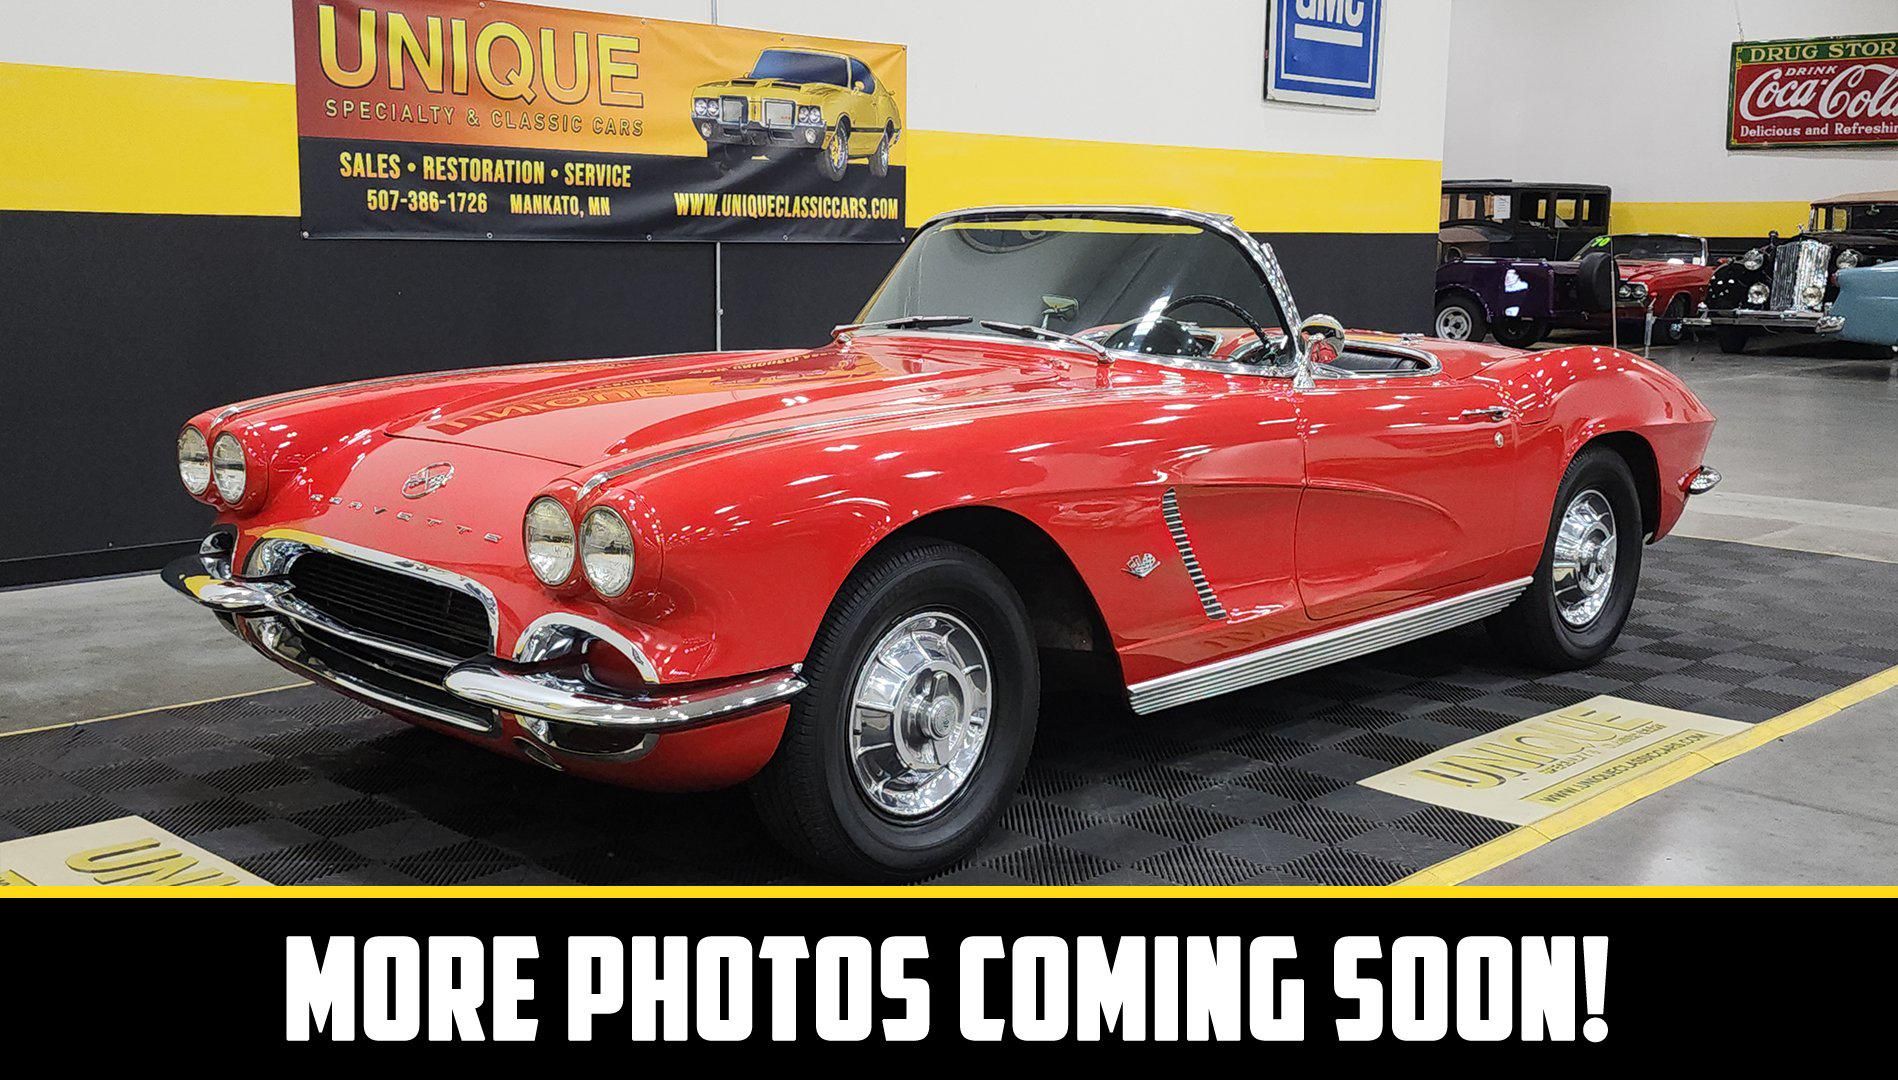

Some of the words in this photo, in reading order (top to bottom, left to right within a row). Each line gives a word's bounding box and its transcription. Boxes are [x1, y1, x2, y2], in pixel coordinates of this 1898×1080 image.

[317, 4, 644, 109] UNIQUE
[1750, 45, 1818, 62] DRUG
[1828, 41, 1898, 59] STOR
[1785, 65, 1838, 76] DRINK
[1739, 63, 1898, 121] Coca-Cola
[325, 98, 455, 125] SPECIALTY
[466, 108, 480, 127] &
[491, 109, 582, 133] CLASSIC
[592, 116, 643, 136] CARS
[1740, 125, 1801, 137] Delicious
[1805, 123, 1828, 135] and
[1834, 121, 1898, 134] Refreshi
[339, 151, 401, 179] SALES
[423, 155, 545, 185] RESTORATION
[564, 162, 632, 188] SERVICE
[366, 189, 488, 214] 507-386-1726
[510, 193, 585, 218] MANKATO,
[588, 196, 611, 216] MN
[673, 192, 899, 220] WWW.UNIQUECLASSICCARS.COM
[1411, 707, 1653, 789] UNIQUE
